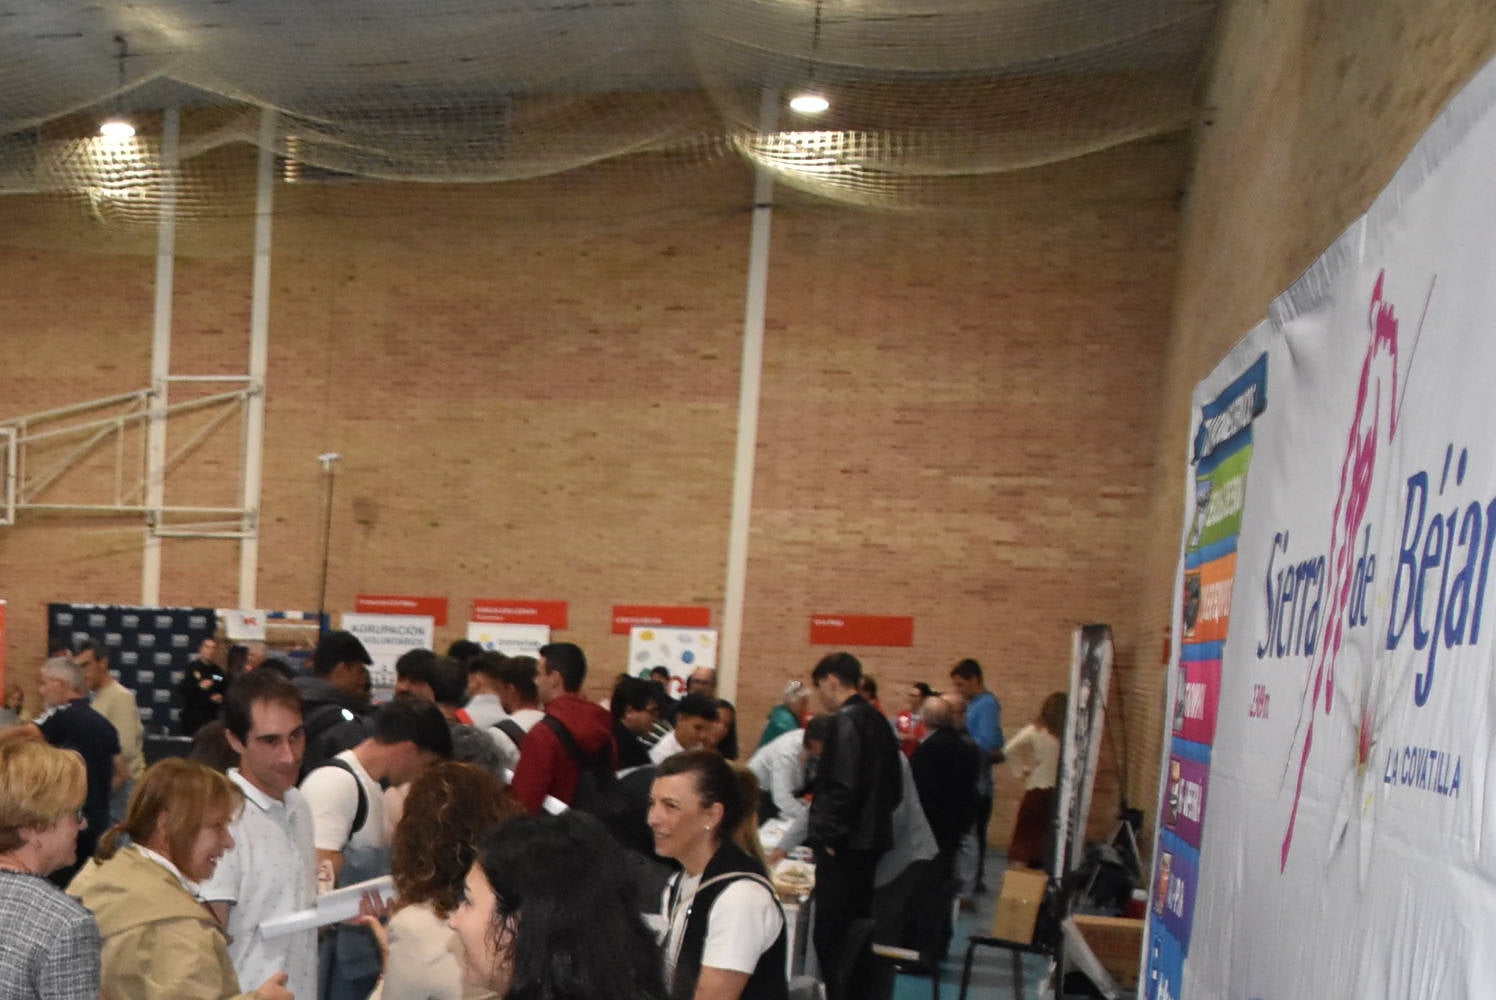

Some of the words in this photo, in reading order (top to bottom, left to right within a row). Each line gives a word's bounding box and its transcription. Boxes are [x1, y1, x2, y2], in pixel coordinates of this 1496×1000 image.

[1256, 529, 1326, 659] Sierra
[1348, 523, 1375, 628] de
[1384, 747, 1399, 786] LA
[1400, 745, 1461, 799] COVATILLA
